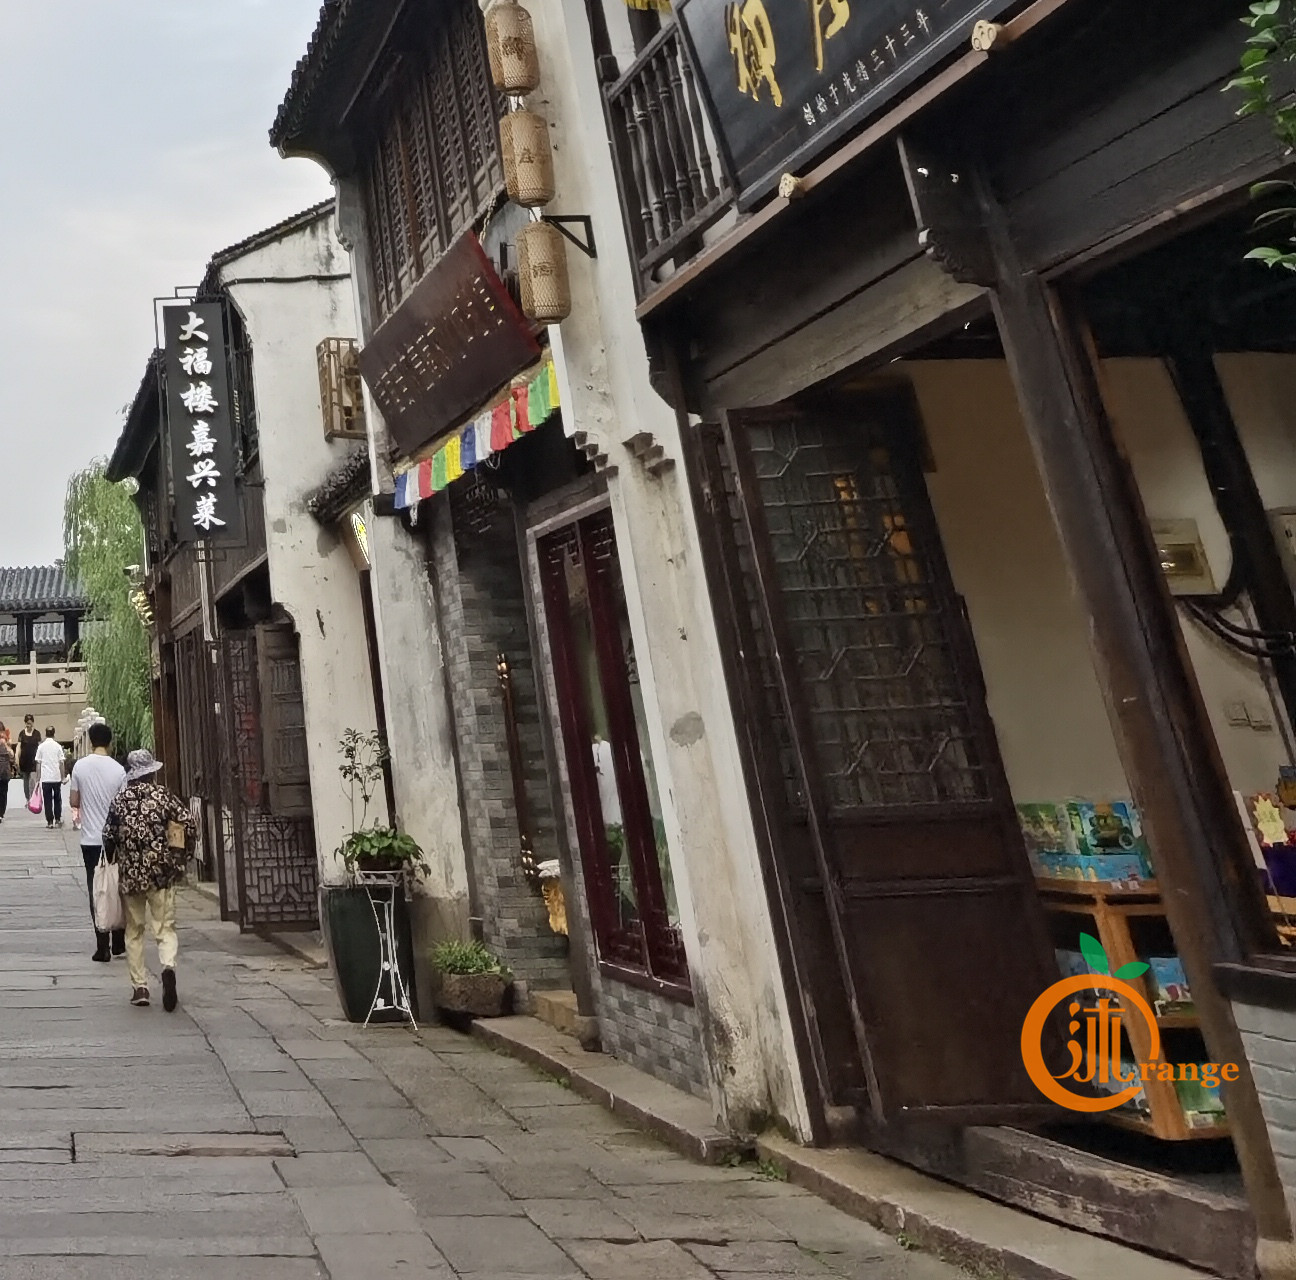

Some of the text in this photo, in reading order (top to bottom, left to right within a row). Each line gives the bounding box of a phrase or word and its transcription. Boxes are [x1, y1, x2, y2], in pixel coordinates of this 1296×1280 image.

[178, 311, 227, 530] 大福楼嘉兴菜
